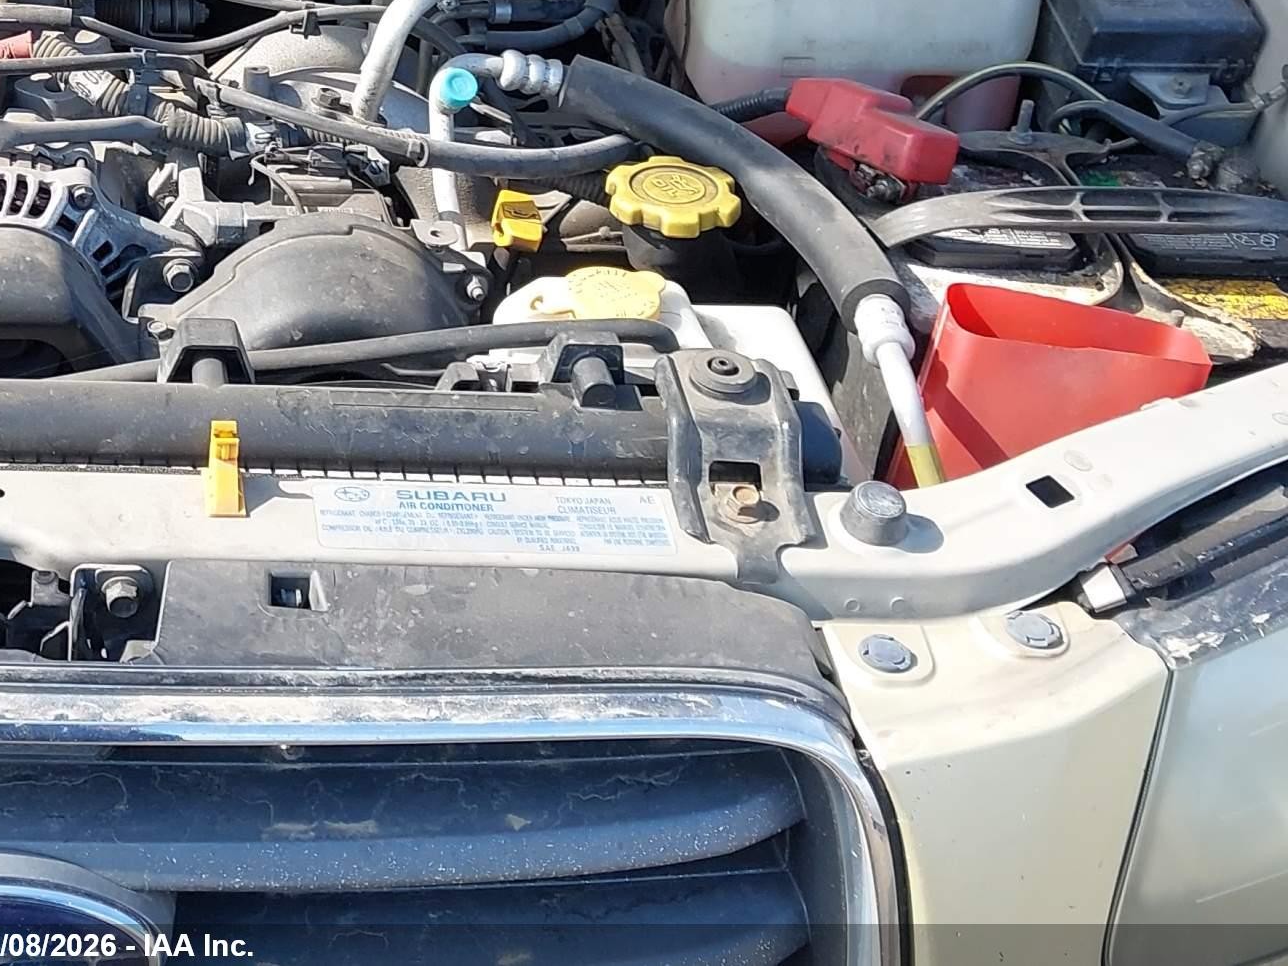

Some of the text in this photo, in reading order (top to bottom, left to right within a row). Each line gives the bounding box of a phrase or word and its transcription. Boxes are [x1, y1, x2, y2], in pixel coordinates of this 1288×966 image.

[651, 178, 679, 198] OIL
[396, 489, 507, 502] SUBARU
[554, 496, 612, 505] TOKYO JAPAN
[399, 501, 495, 512] AIR CONDITIONER
[557, 505, 617, 515] CLIMATISEUR
